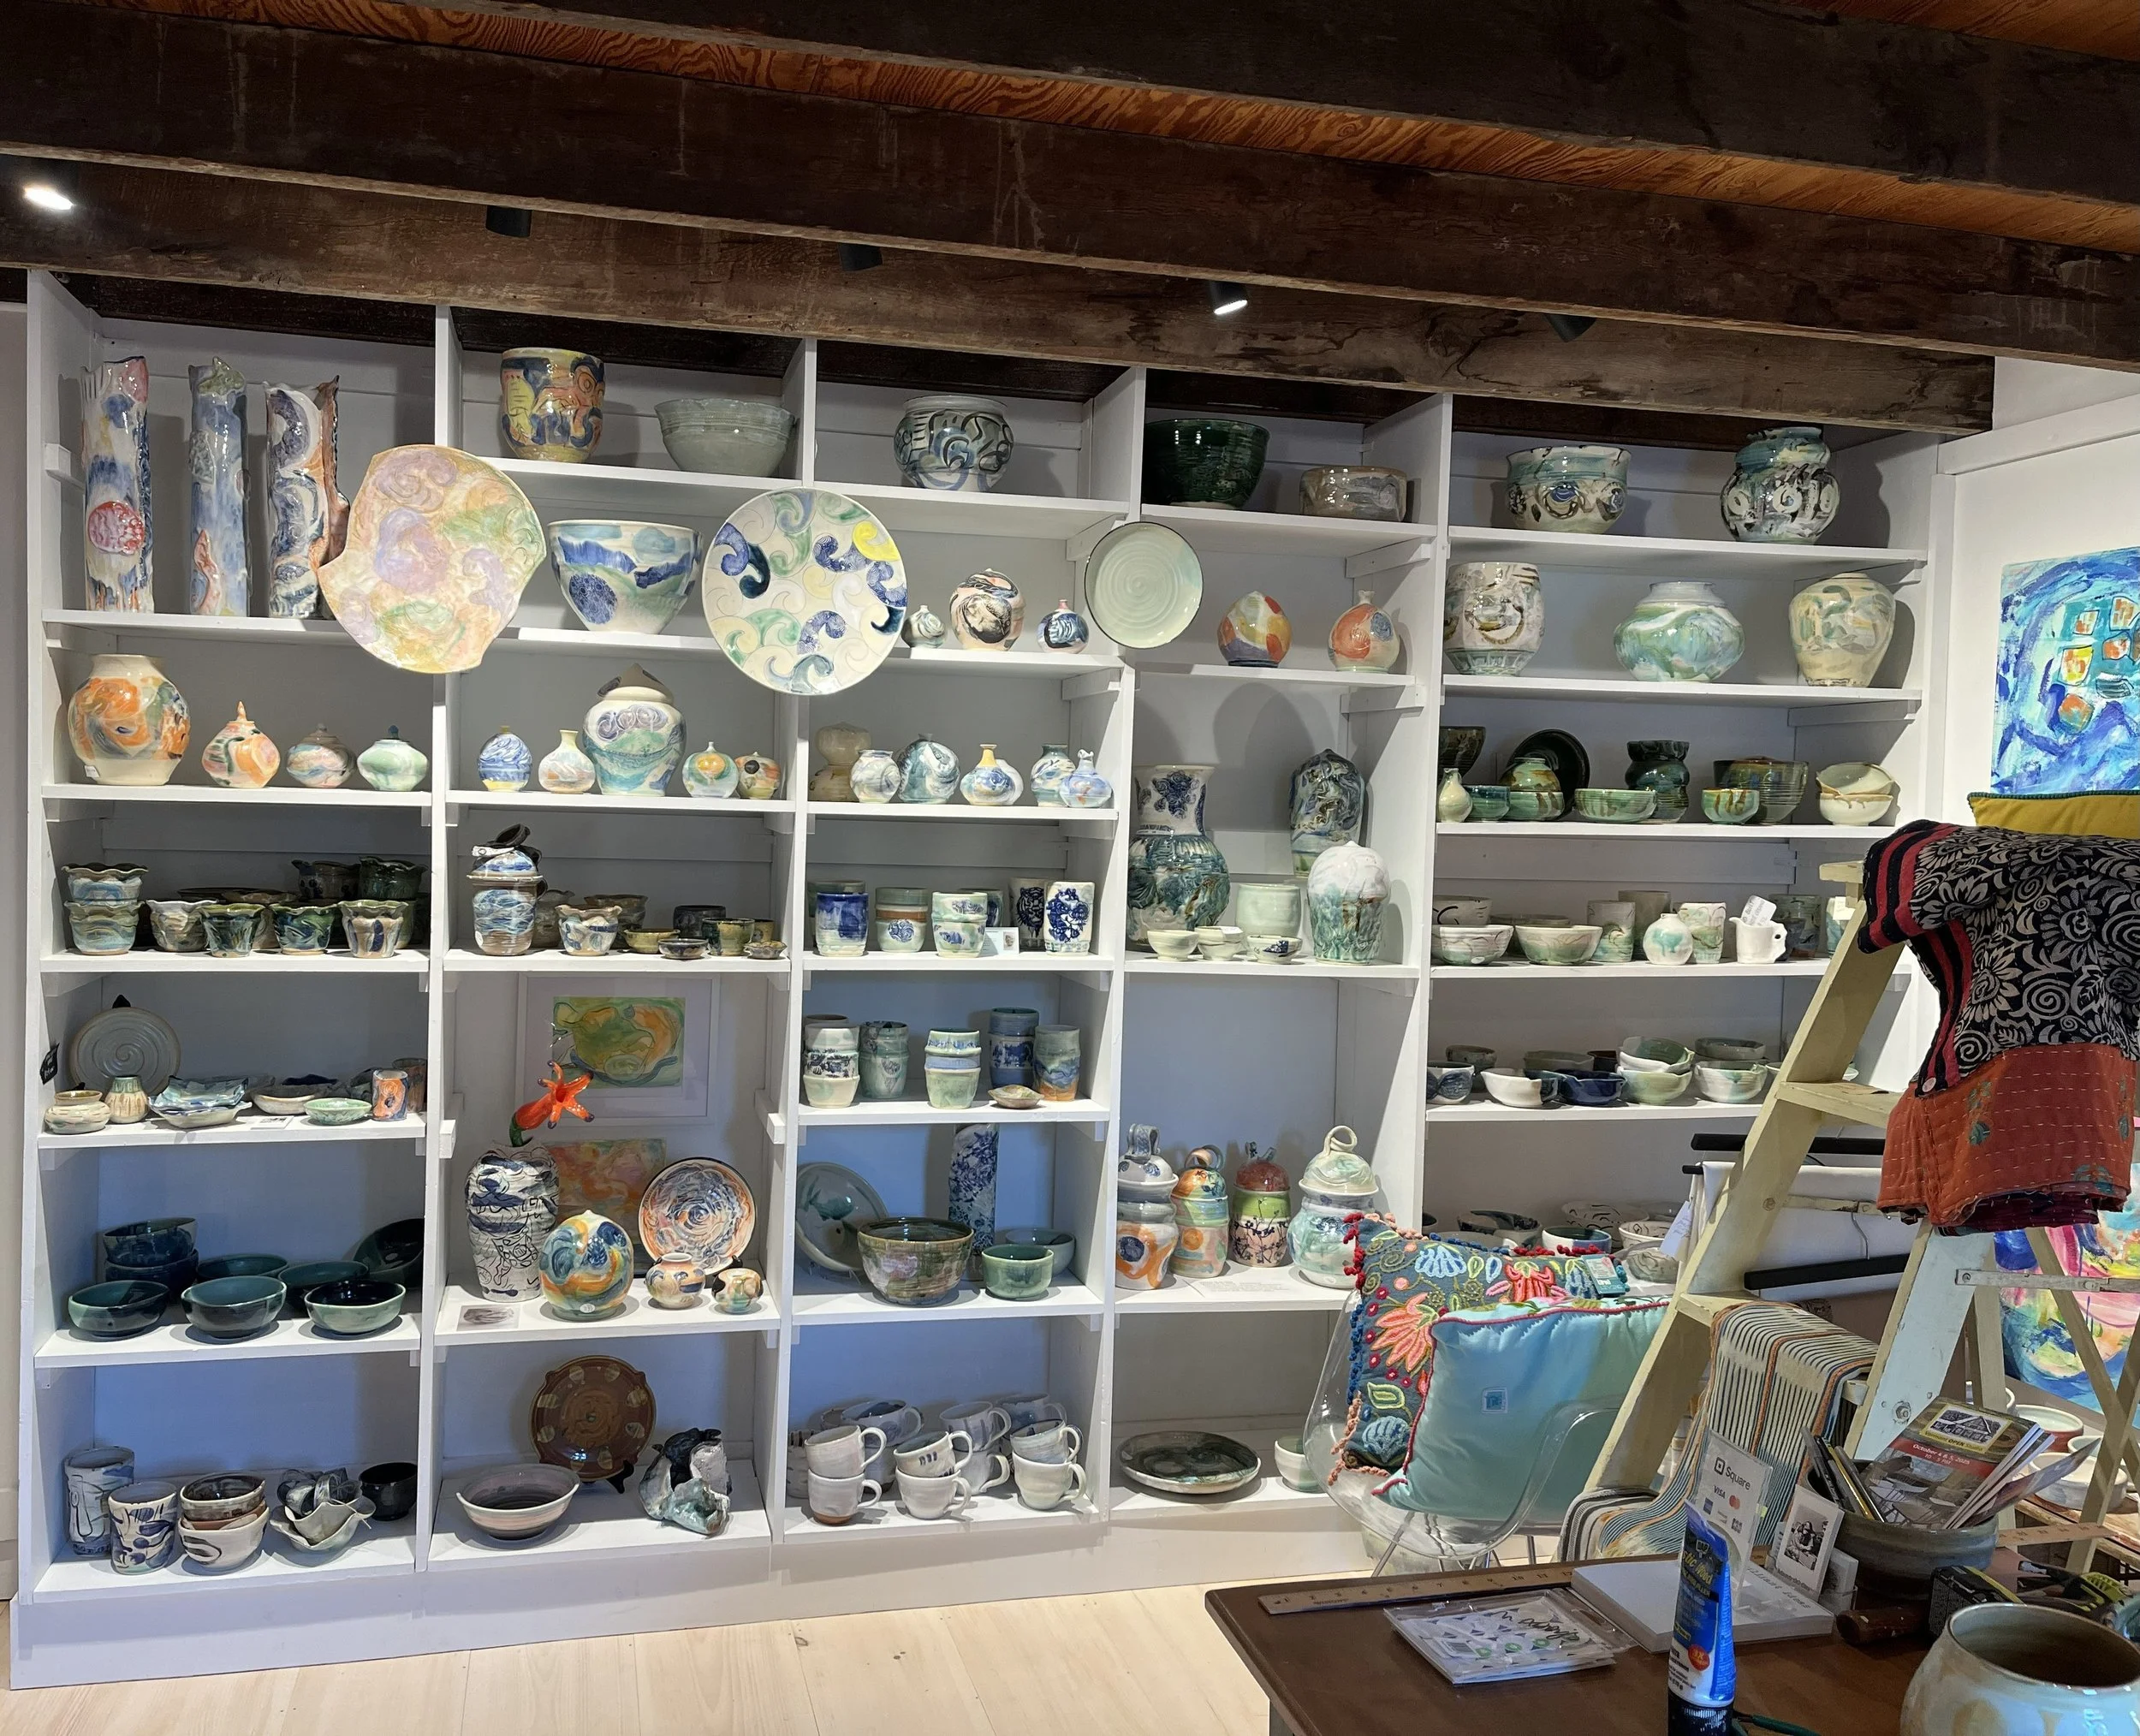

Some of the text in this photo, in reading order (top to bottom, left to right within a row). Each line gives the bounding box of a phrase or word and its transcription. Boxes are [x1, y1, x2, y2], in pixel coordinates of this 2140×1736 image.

[1912, 1443, 1937, 1455] October
[1725, 1466, 1751, 1490] Square
[1714, 1484, 1726, 1499] VISA
[1695, 1562, 1714, 1585] Wood
